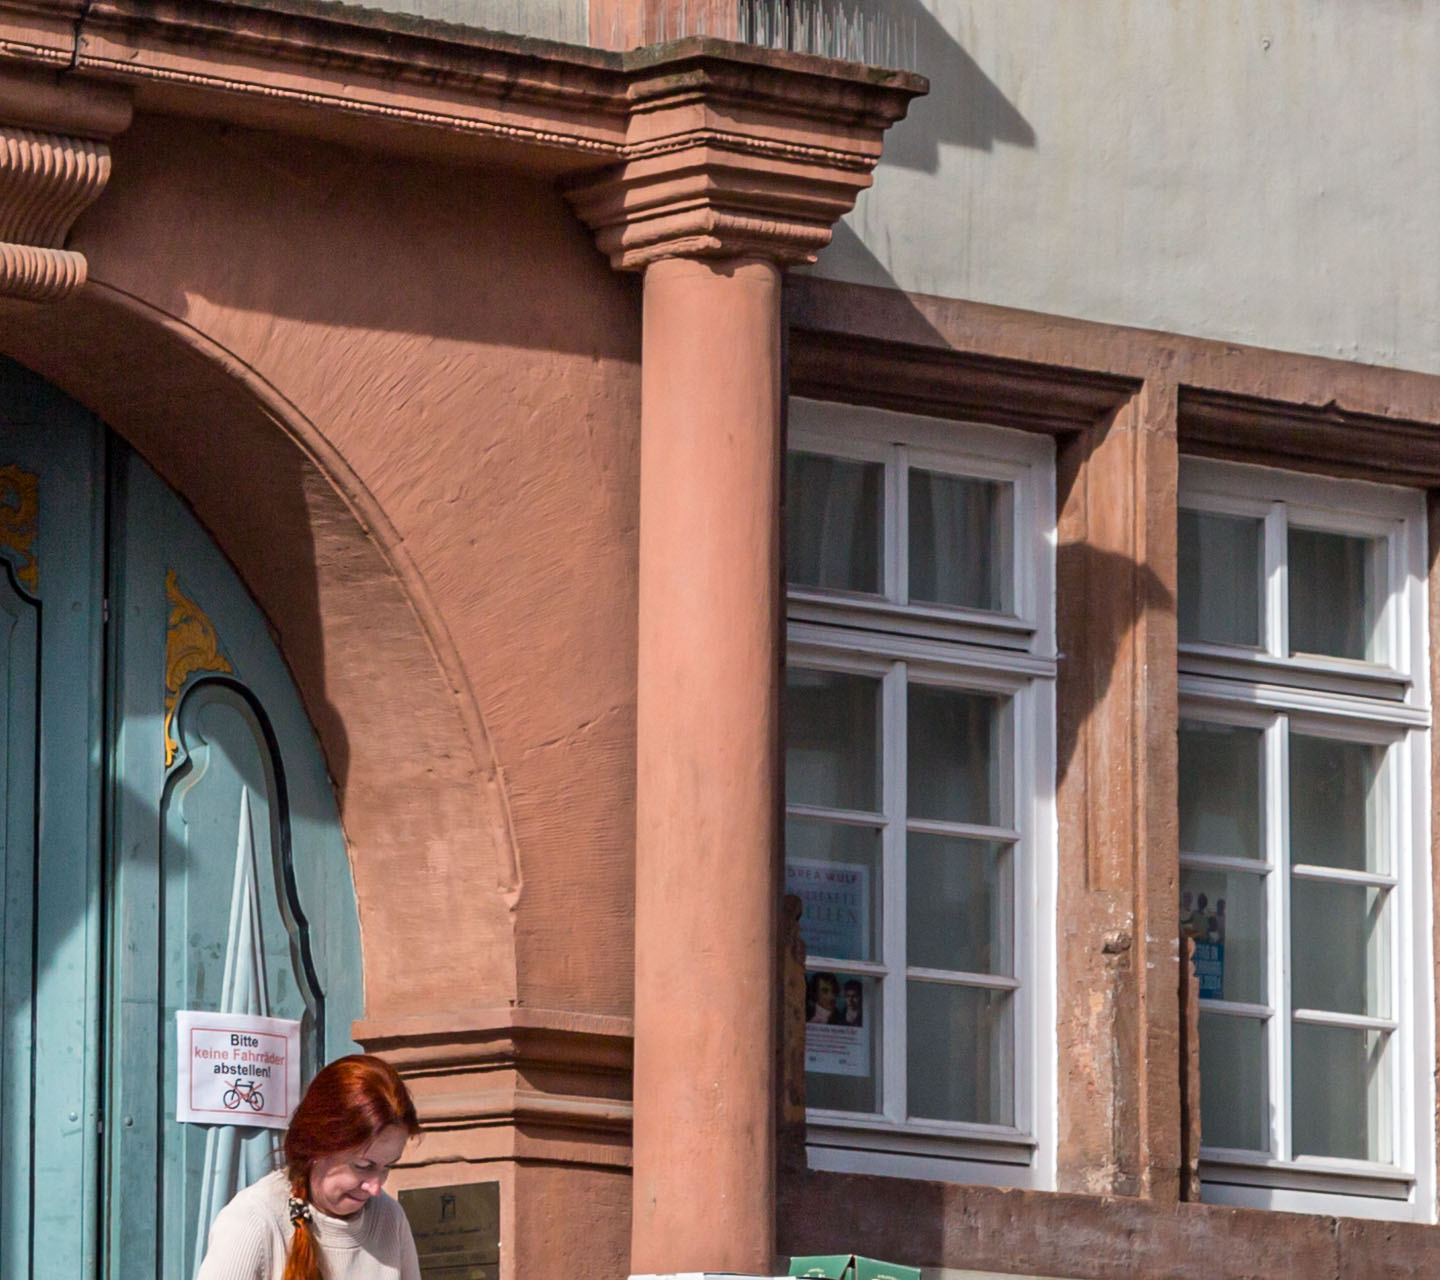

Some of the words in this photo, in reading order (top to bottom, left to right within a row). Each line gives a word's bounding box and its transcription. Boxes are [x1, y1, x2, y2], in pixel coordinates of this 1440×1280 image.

[230, 1033, 259, 1048] Bitte
[194, 1046, 229, 1060] keine
[233, 1049, 285, 1065] Fahrräder
[213, 1062, 271, 1079] abstellen!
